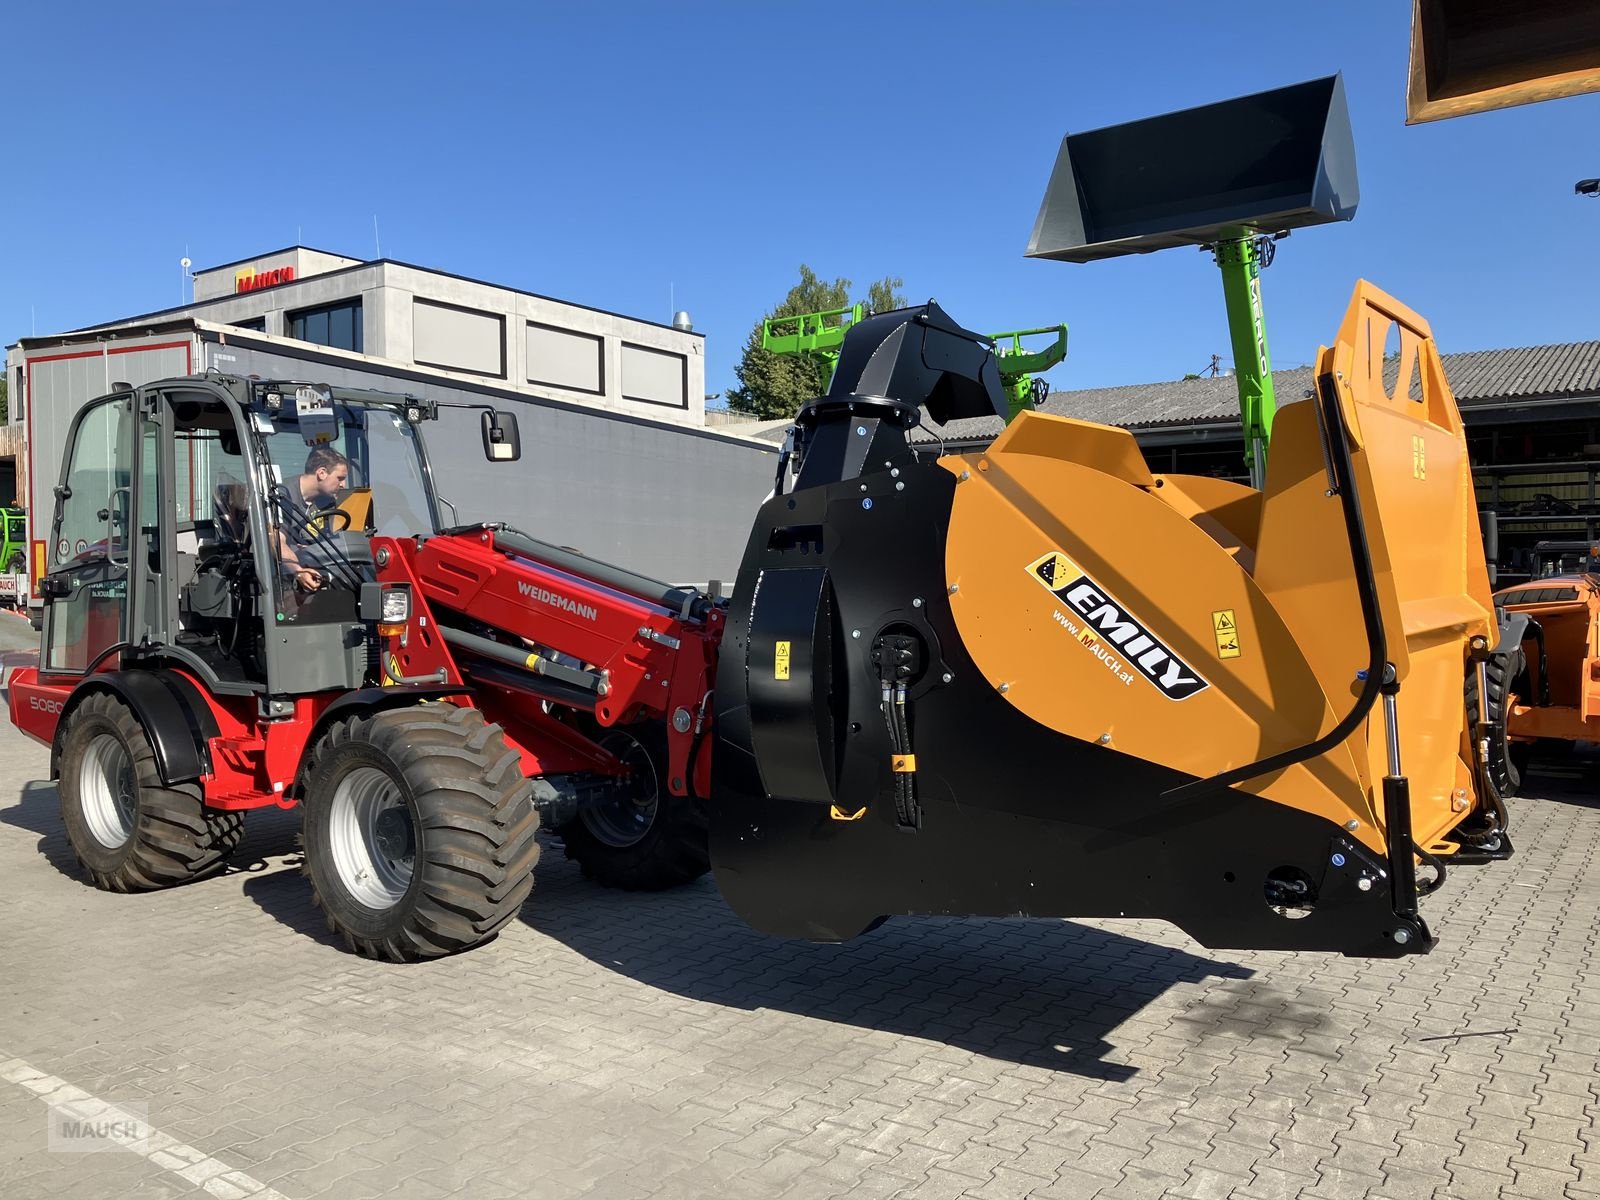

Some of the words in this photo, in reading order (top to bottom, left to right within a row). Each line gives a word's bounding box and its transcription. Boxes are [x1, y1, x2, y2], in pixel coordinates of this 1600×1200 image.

[237, 266, 294, 294] MAUCH
[1250, 278, 1268, 378] MERLO
[517, 580, 597, 621] WEIDEMANN
[1052, 609, 1135, 686] www.MAUCH.at
[1066, 584, 1198, 689] EMILY
[30, 696, 64, 714] 5080
